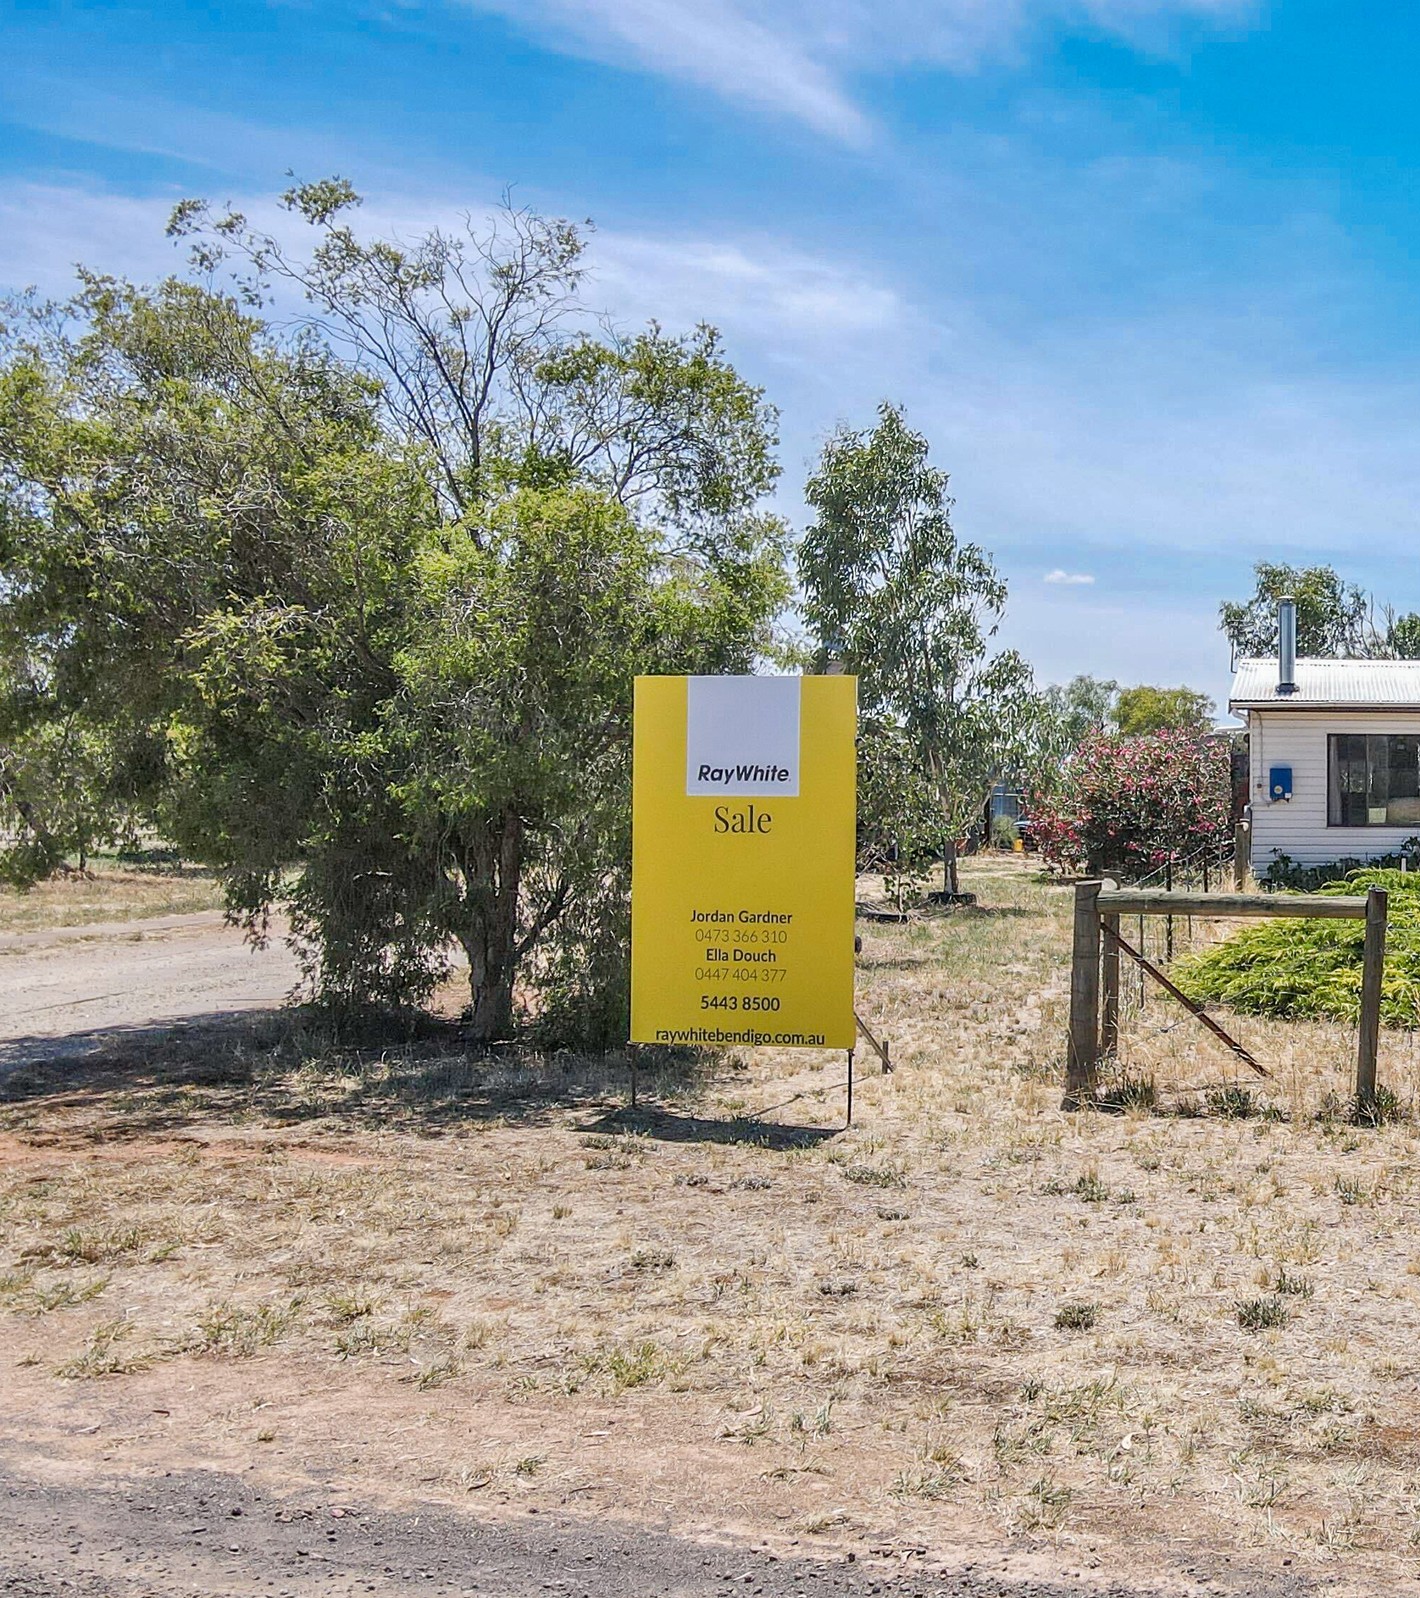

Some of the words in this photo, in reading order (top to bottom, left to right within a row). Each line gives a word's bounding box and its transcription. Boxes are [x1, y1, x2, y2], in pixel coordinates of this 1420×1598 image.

[714, 804, 773, 834] Sale
[690, 910, 735, 923] Jordan
[738, 910, 793, 924] Gardner
[695, 928, 729, 943] 0473
[733, 929, 758, 943] 366
[761, 930, 788, 943] 310
[706, 948, 729, 961] Ella
[733, 949, 776, 962] Douch
[695, 967, 729, 981] 0447
[732, 967, 758, 982] 404
[761, 968, 787, 982] 377
[701, 995, 738, 1010] 5443
[742, 996, 781, 1011] 8500
[656, 1028, 825, 1045] raywhitebendigo.com.au
